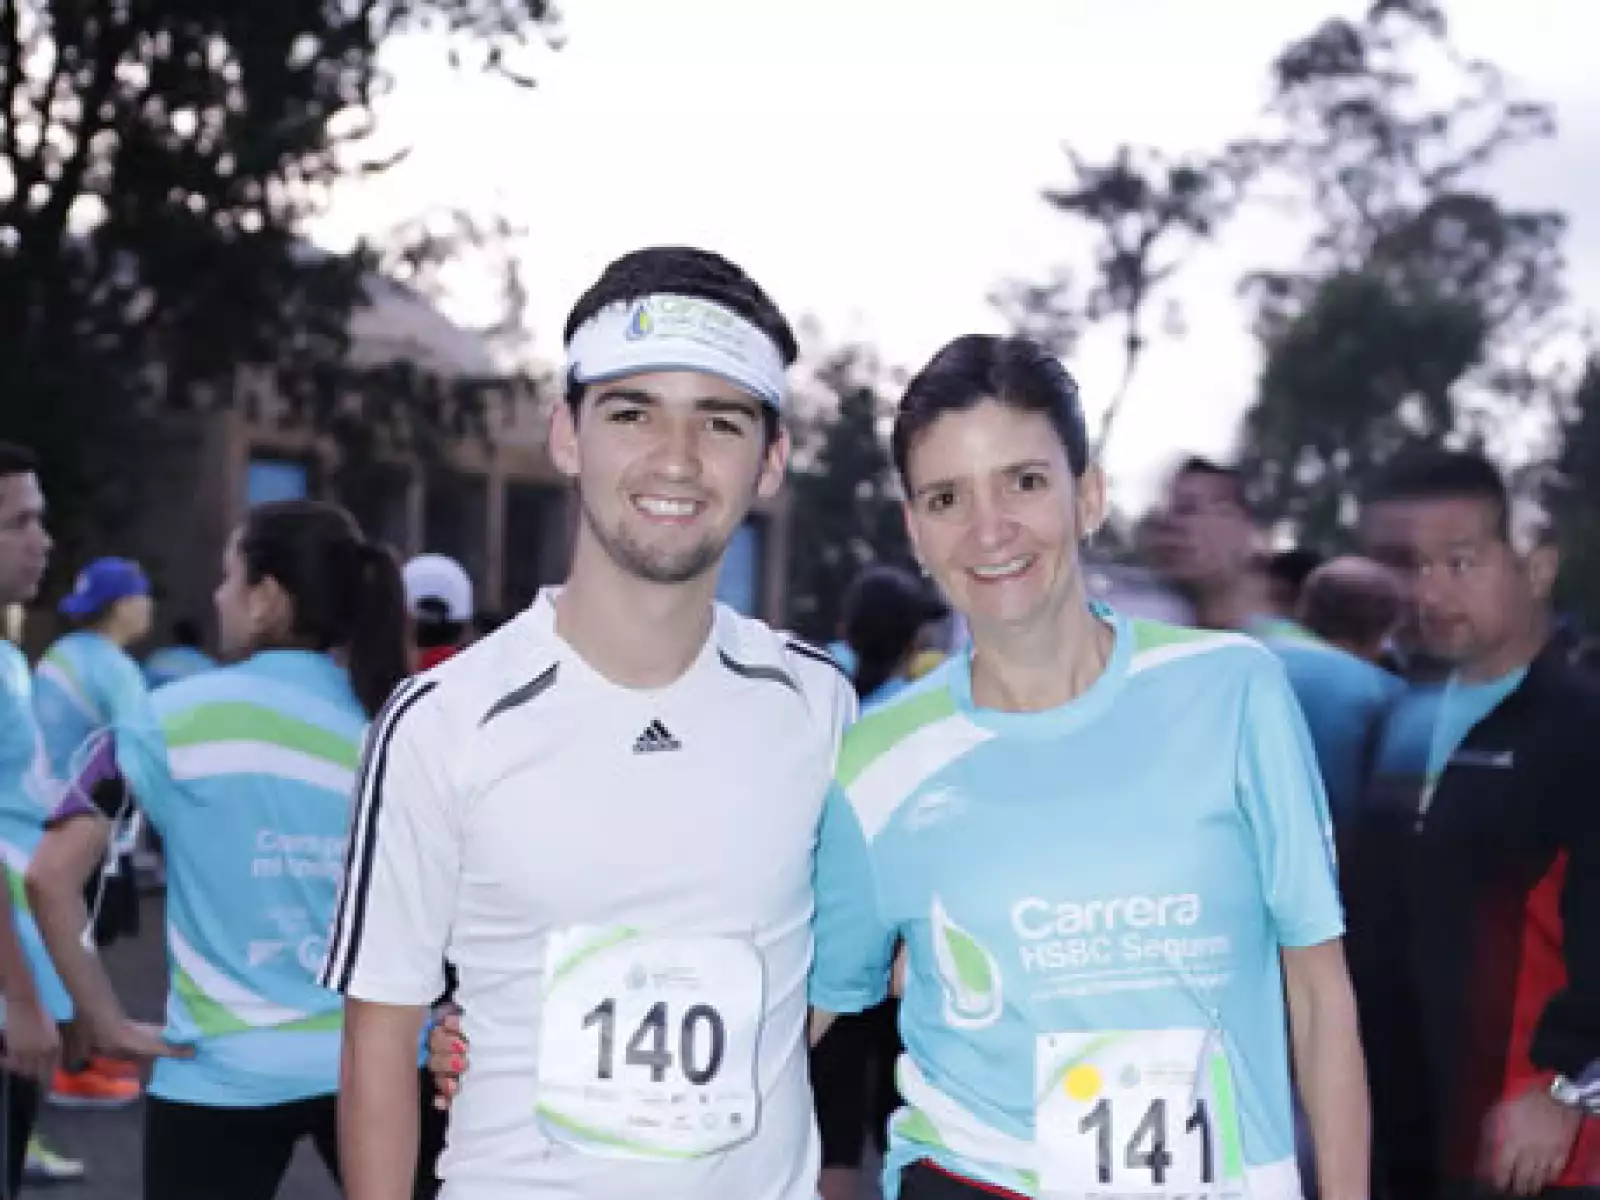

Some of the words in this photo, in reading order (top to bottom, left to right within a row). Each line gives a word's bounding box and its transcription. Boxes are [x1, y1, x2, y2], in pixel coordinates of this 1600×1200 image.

[1011, 893, 1200, 940] Carrera
[1019, 936, 1111, 973] HSBC
[581, 997, 725, 1085] 140
[1078, 1099, 1214, 1183] 141
